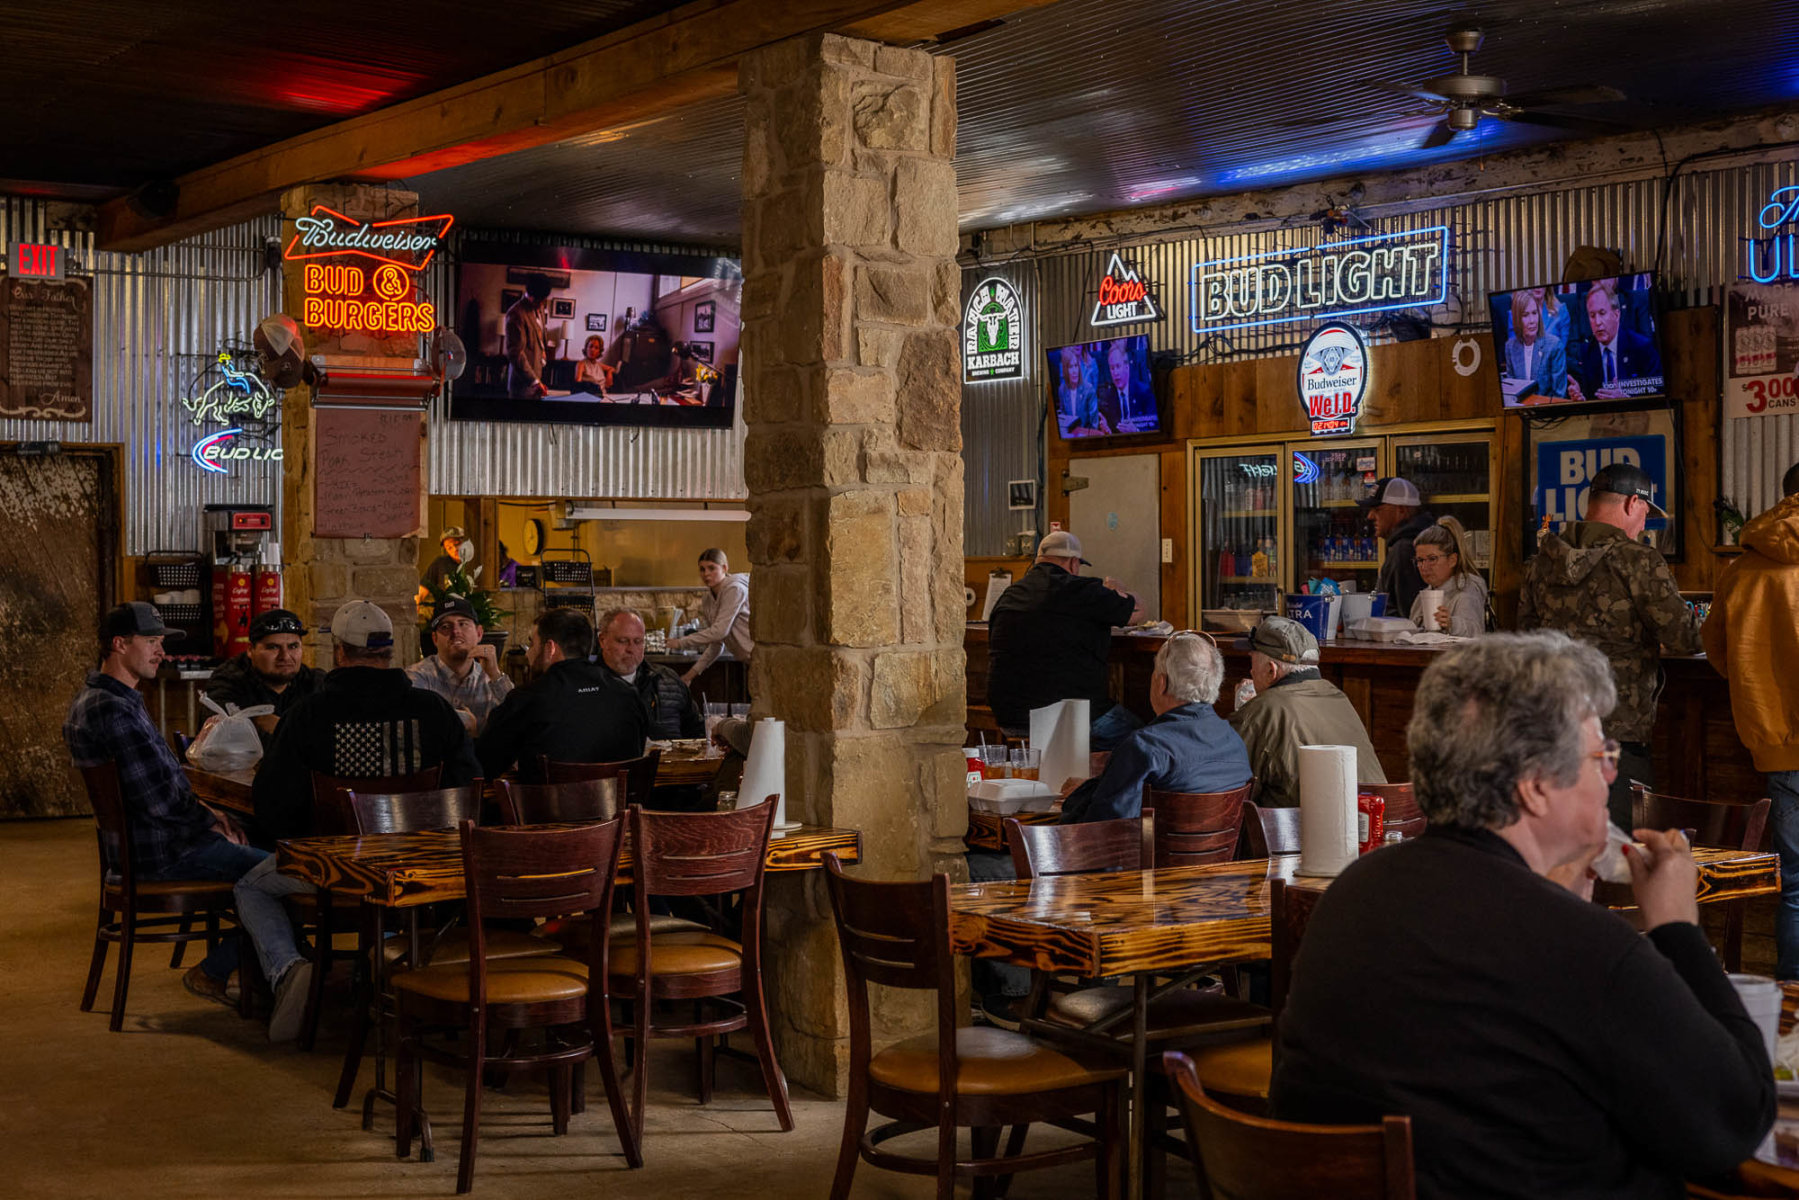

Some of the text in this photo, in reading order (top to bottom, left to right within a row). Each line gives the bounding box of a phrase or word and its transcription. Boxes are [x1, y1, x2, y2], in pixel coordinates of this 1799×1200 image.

[296, 217, 437, 250] Budweiser
[18, 243, 58, 276] EXIT
[304, 263, 405, 297] BUD &
[1099, 275, 1147, 306] Coors
[1201, 243, 1438, 321] BUD LIGHT
[304, 297, 435, 332] BURGERS
[967, 283, 1020, 355] RANCH WATER
[1106, 301, 1137, 319] LIGHT
[1747, 303, 1790, 321] PURE
[967, 351, 1020, 370] KARBACH
[1307, 376, 1357, 391] Budweiser
[1621, 377, 1663, 388] INVESTIGATES
[40, 390, 80, 405] Amen
[1768, 398, 1796, 409] CANS
[203, 445, 250, 460] BUD
[1560, 447, 1641, 485] BUD
